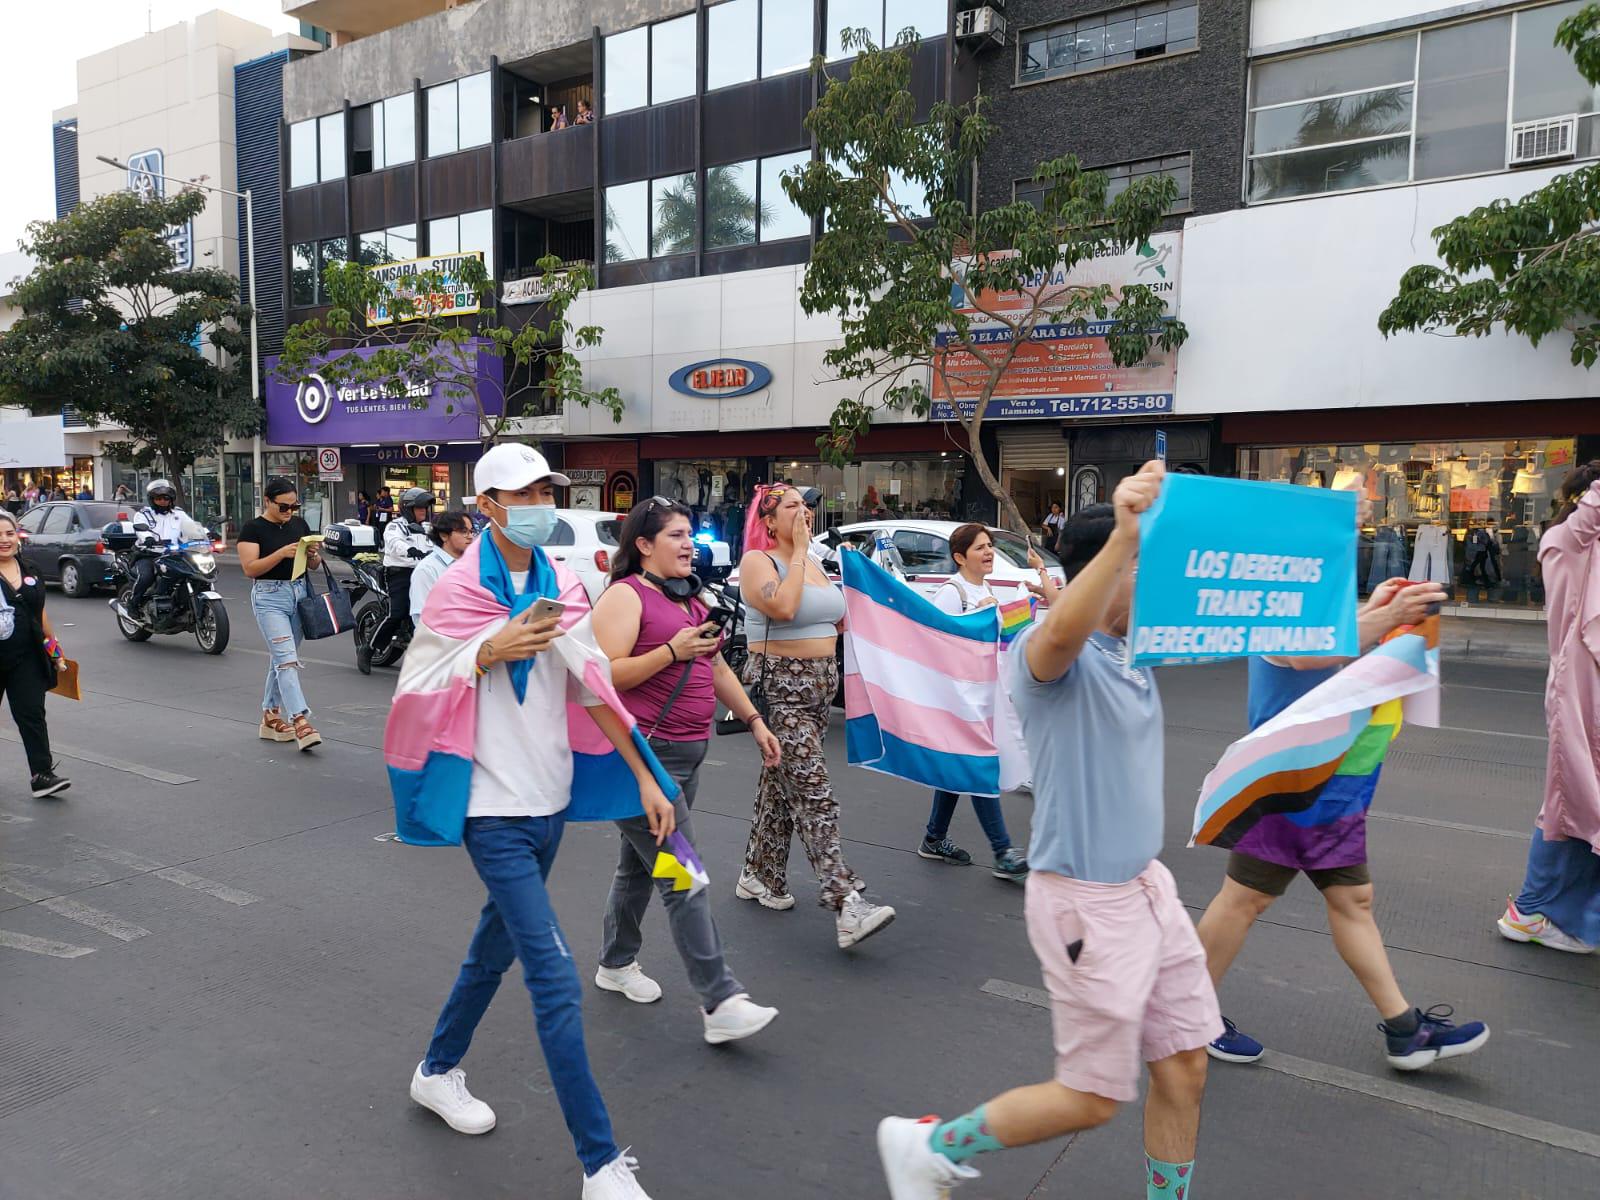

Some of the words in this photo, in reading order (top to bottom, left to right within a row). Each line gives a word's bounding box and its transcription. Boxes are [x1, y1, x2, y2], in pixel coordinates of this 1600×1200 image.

[979, 331, 993, 342] EL
[1060, 326, 1083, 337] SUS
[710, 367, 747, 387] JEAN
[337, 387, 359, 401] Ver
[1049, 396, 1167, 412] Tel.712-55-80
[323, 453, 335, 463] 30
[1185, 549, 1229, 578] LOS
[1228, 552, 1324, 583] DERECHOS
[1196, 588, 1263, 617] TRANS
[1263, 591, 1304, 617] SON
[1135, 626, 1247, 655] DERECHOS
